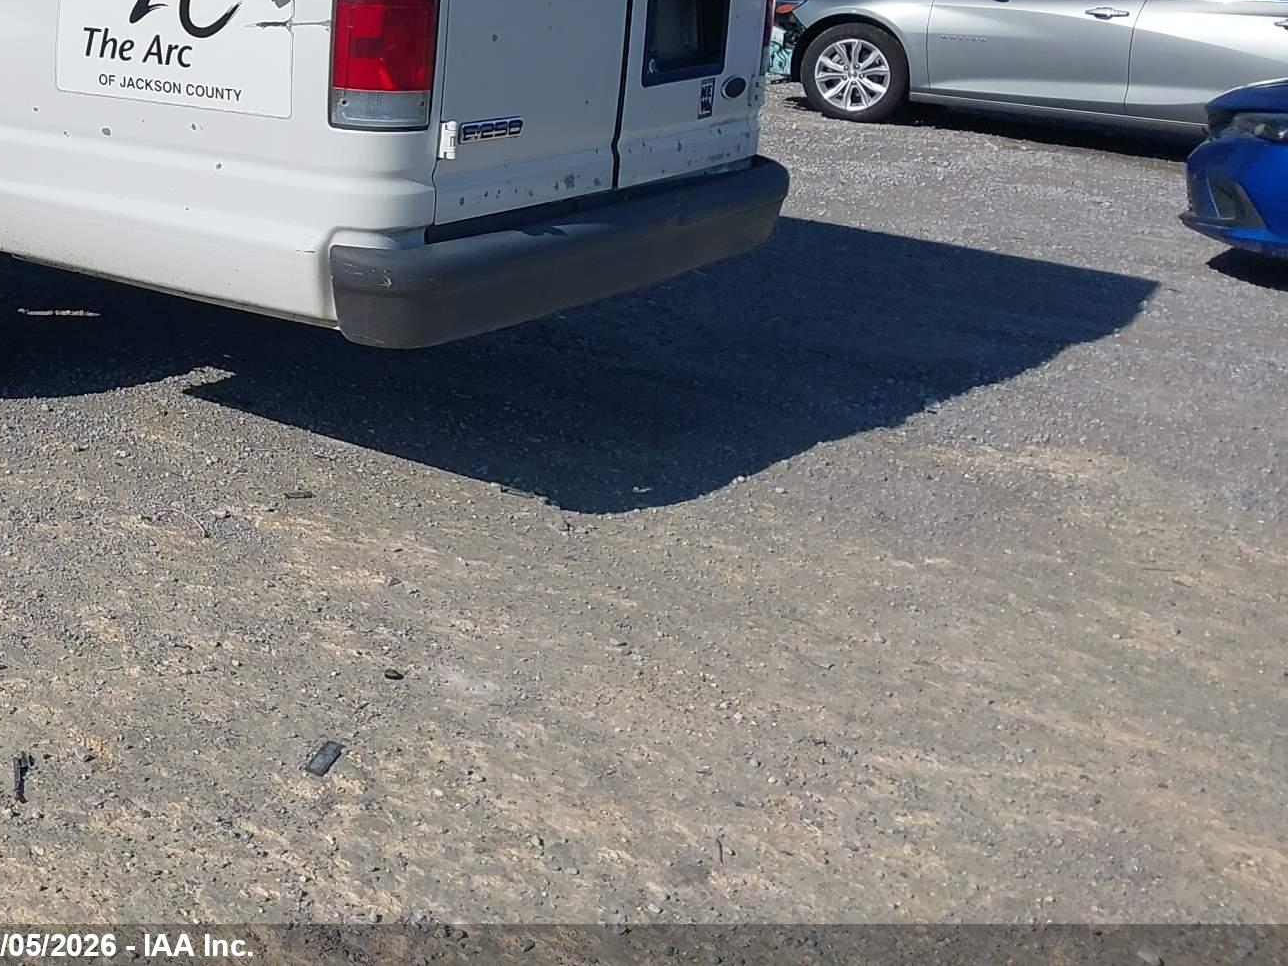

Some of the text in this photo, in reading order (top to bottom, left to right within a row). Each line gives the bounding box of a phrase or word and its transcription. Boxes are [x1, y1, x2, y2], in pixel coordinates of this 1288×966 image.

[83, 27, 193, 68] The Arc
[98, 73, 242, 101] OF JACKSON COUNTY
